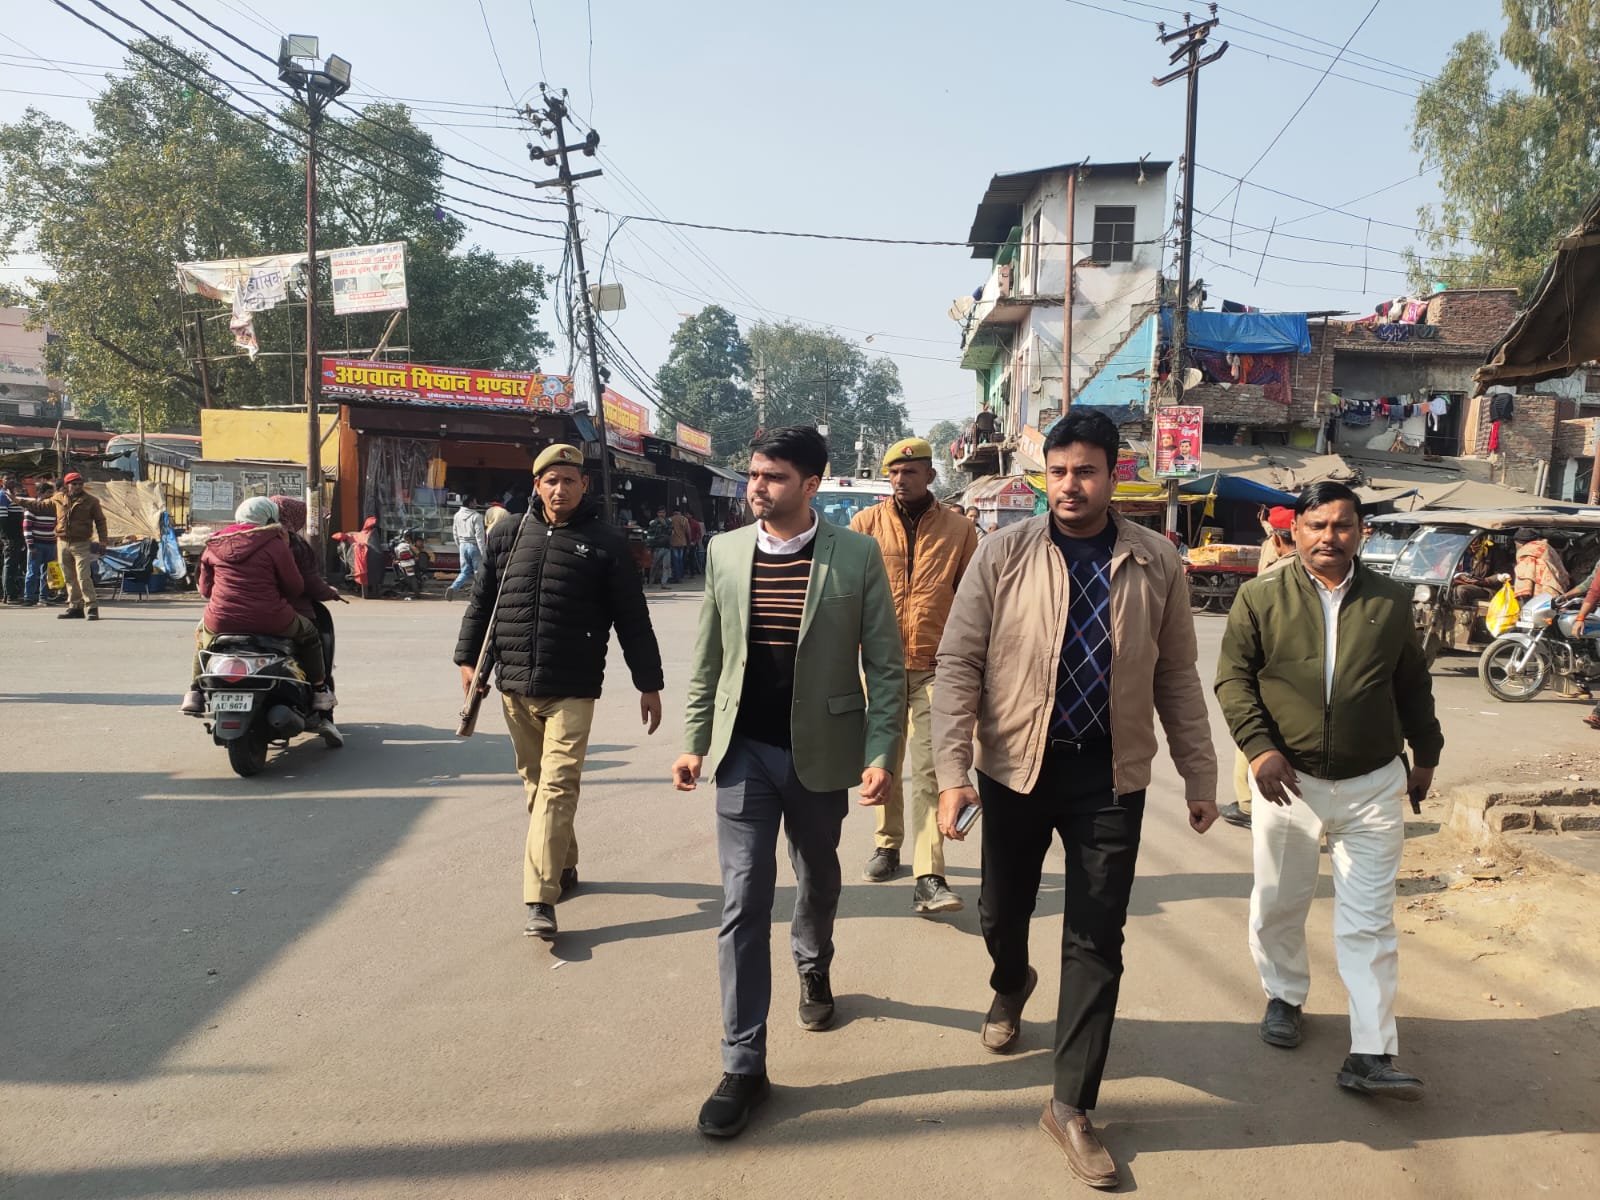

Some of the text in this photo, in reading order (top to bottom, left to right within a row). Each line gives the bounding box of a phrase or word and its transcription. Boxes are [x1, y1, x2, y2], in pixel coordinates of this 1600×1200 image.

[322, 385, 366, 395] लाला
[335, 366, 408, 388] अग्रवाल
[411, 367, 472, 393] मिष्ठान
[476, 377, 529, 397] भण्डार
